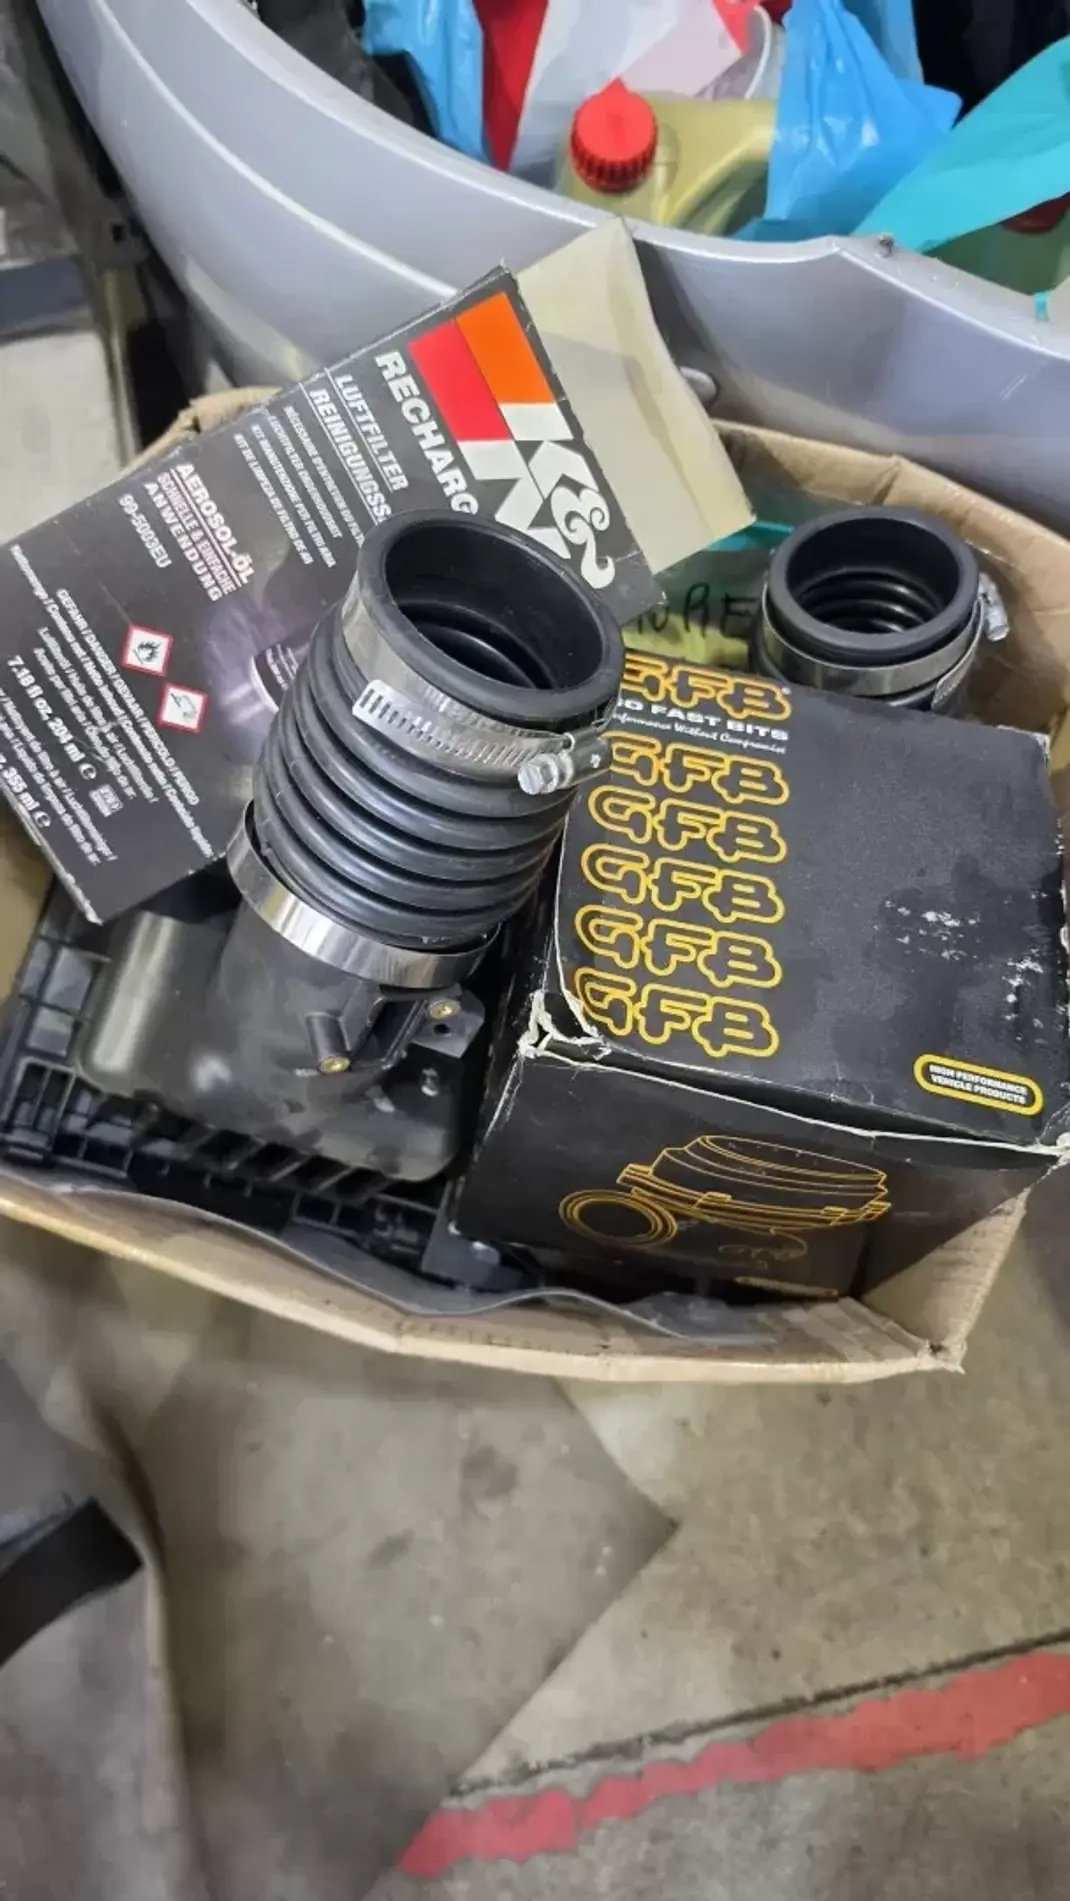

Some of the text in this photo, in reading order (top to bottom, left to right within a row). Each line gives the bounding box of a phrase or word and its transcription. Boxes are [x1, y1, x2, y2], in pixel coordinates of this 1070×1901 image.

[310, 389, 390, 521] REINIGUNGSS
[334, 375, 408, 489] LUFTFILTER
[119, 494, 171, 567] 99-5003EU
[144, 482, 222, 600] ANWENDUNG
[157, 472, 236, 594] SCHNELLE & EINFACHE
[176, 464, 253, 583] AEROSOL-ÖL
[7, 655, 35, 687] 7.18
[47, 717, 73, 744] 204
[63, 742, 86, 762] ml
[650, 704, 721, 726] FAST
[726, 720, 789, 741] BITS
[1, 766, 27, 793] 355
[18, 791, 40, 813] ml
[588, 785, 787, 863] GFB
[581, 843, 785, 923] GFB
[575, 904, 782, 988] GFB
[574, 966, 780, 1057] GFB
[929, 1064, 1028, 1095] HIGH PERFORMANCE
[930, 1073, 1027, 1105] VEHICLE PRODUCTS
